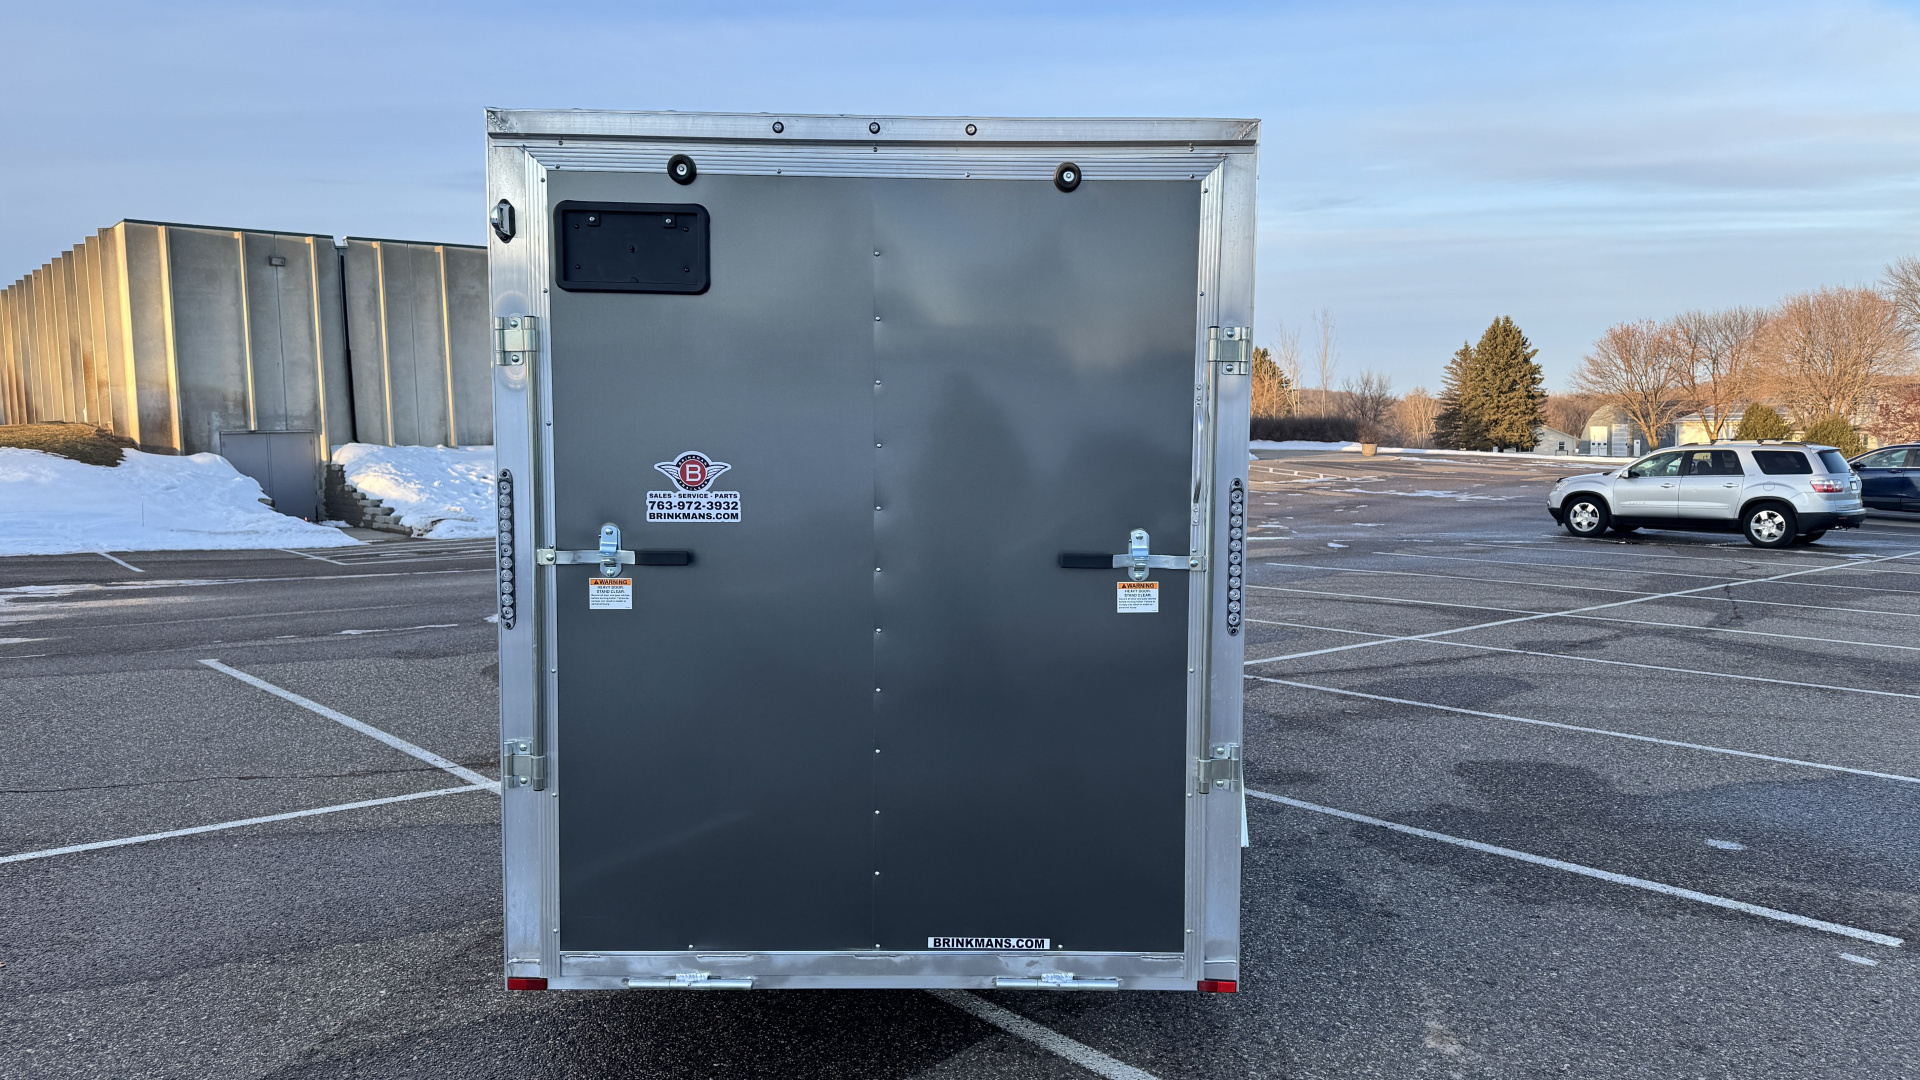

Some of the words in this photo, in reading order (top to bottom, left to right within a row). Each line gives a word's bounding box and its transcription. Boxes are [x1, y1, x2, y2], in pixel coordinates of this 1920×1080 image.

[685, 464, 702, 482] B
[648, 501, 739, 510] 763-972-3932
[933, 938, 1044, 948] BRINKMANS.COM
